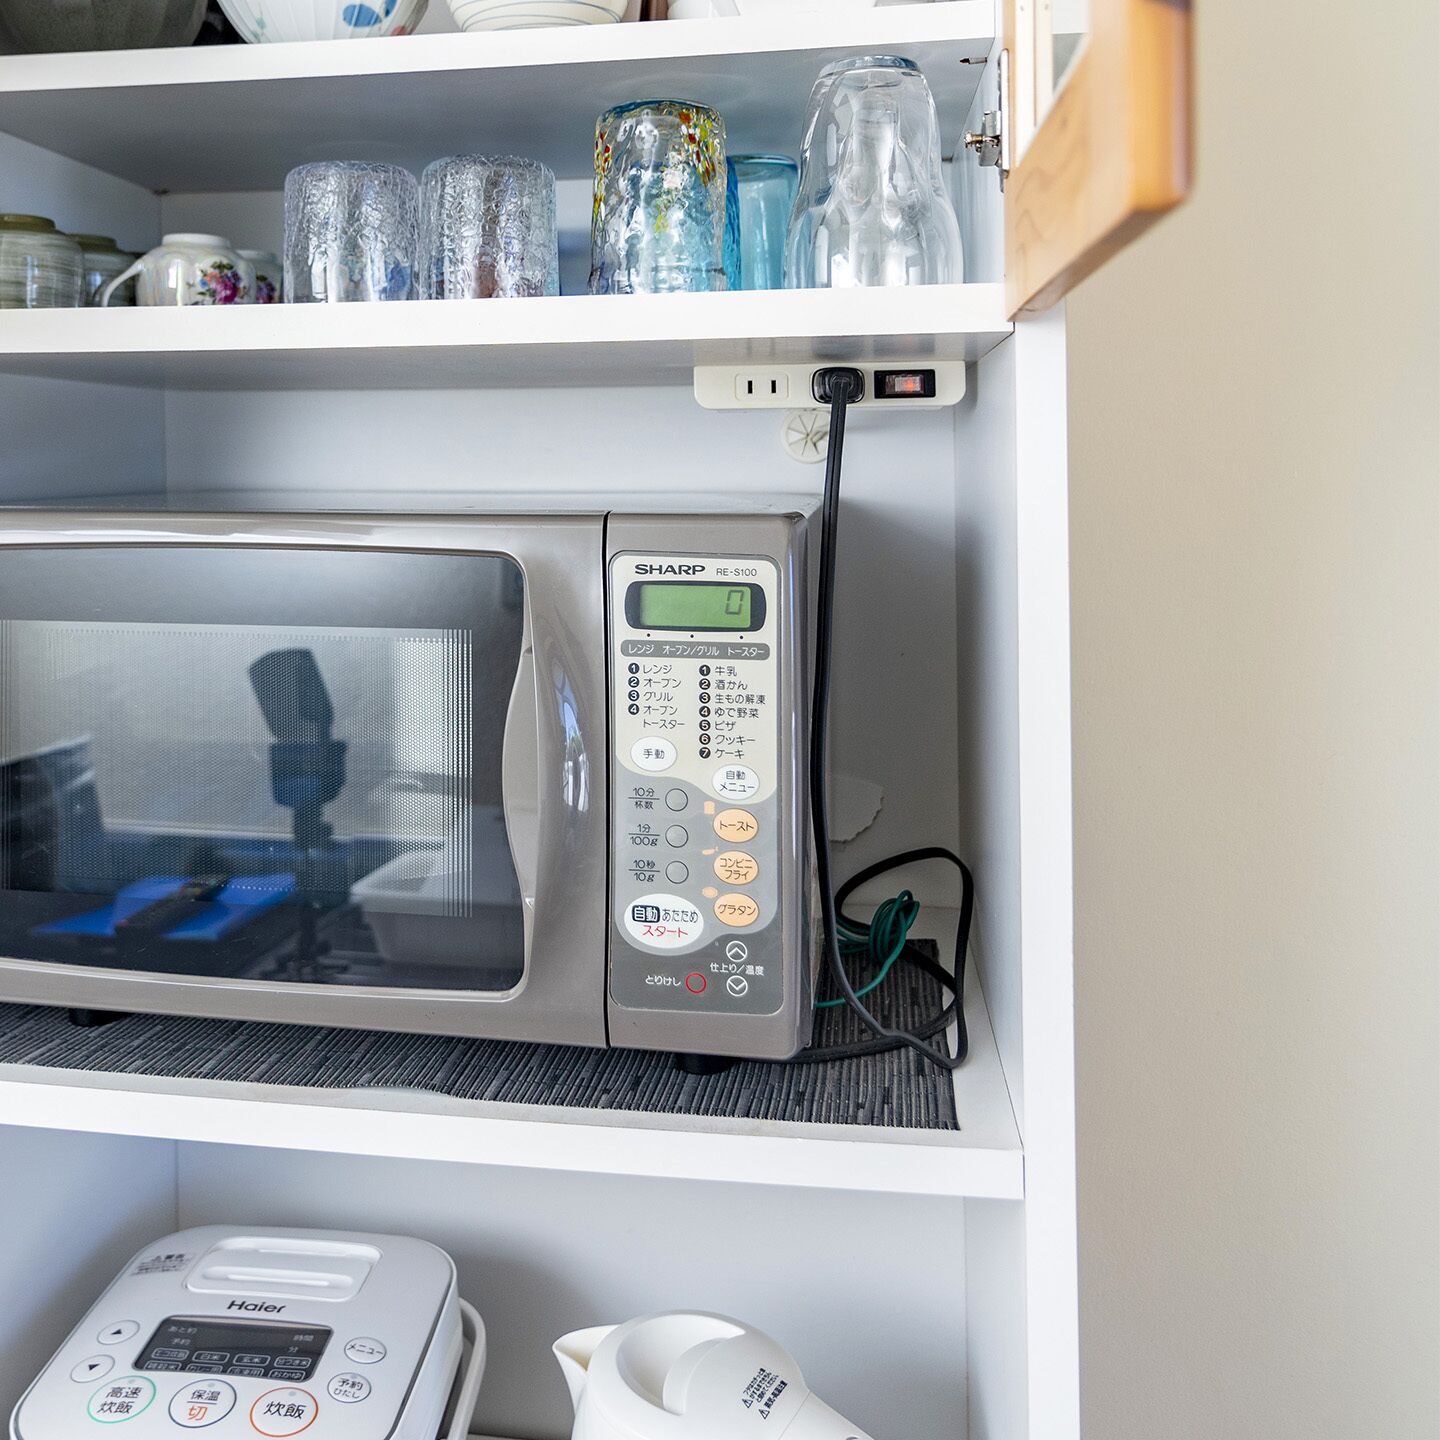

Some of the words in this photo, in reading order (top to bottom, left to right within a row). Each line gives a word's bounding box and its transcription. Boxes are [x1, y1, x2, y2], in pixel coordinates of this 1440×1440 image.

[635, 563, 706, 576] SHARP
[716, 568, 758, 577] RE-S100
[725, 589, 745, 615] 0
[628, 643, 655, 655] レンジ
[727, 646, 765, 657] トースター
[643, 664, 673, 675] レンジ
[714, 665, 738, 677] 牛乳
[643, 678, 682, 689] オーブン
[714, 679, 748, 691] 酒かん
[643, 691, 674, 702] グリル
[714, 693, 766, 705] 生もの解凍
[643, 705, 678, 716] オーブン
[714, 706, 760, 719] ゆで野菜
[643, 718, 686, 730] トースター
[714, 720, 737, 732] ピザ
[714, 734, 757, 746] クッキー
[643, 748, 665, 760] 手動
[714, 748, 745, 760] ケーキ
[725, 770, 746, 781] 自動
[632, 787, 656, 798] 10分
[719, 781, 756, 793] メニュー
[633, 800, 655, 810] 杯数
[636, 823, 652, 834] 1分
[719, 820, 755, 832] トースト
[630, 835, 659, 847] 100g
[632, 859, 657, 870] 10秒
[719, 857, 754, 869] コンビニ
[633, 872, 656, 883] 10g
[724, 869, 751, 881] フライ
[717, 903, 757, 916] グラタン
[642, 924, 690, 938] スタート
[645, 974, 682, 987] とりけし
[226, 1299, 288, 1314] Haier
[346, 1342, 384, 1355] メニュー
[338, 1378, 364, 1391] 予約
[106, 1386, 143, 1399] 高速
[190, 1389, 221, 1402] 保温
[96, 1401, 136, 1415] 炊飯
[187, 1404, 208, 1421] 切
[263, 1402, 307, 1420] 炊飯
